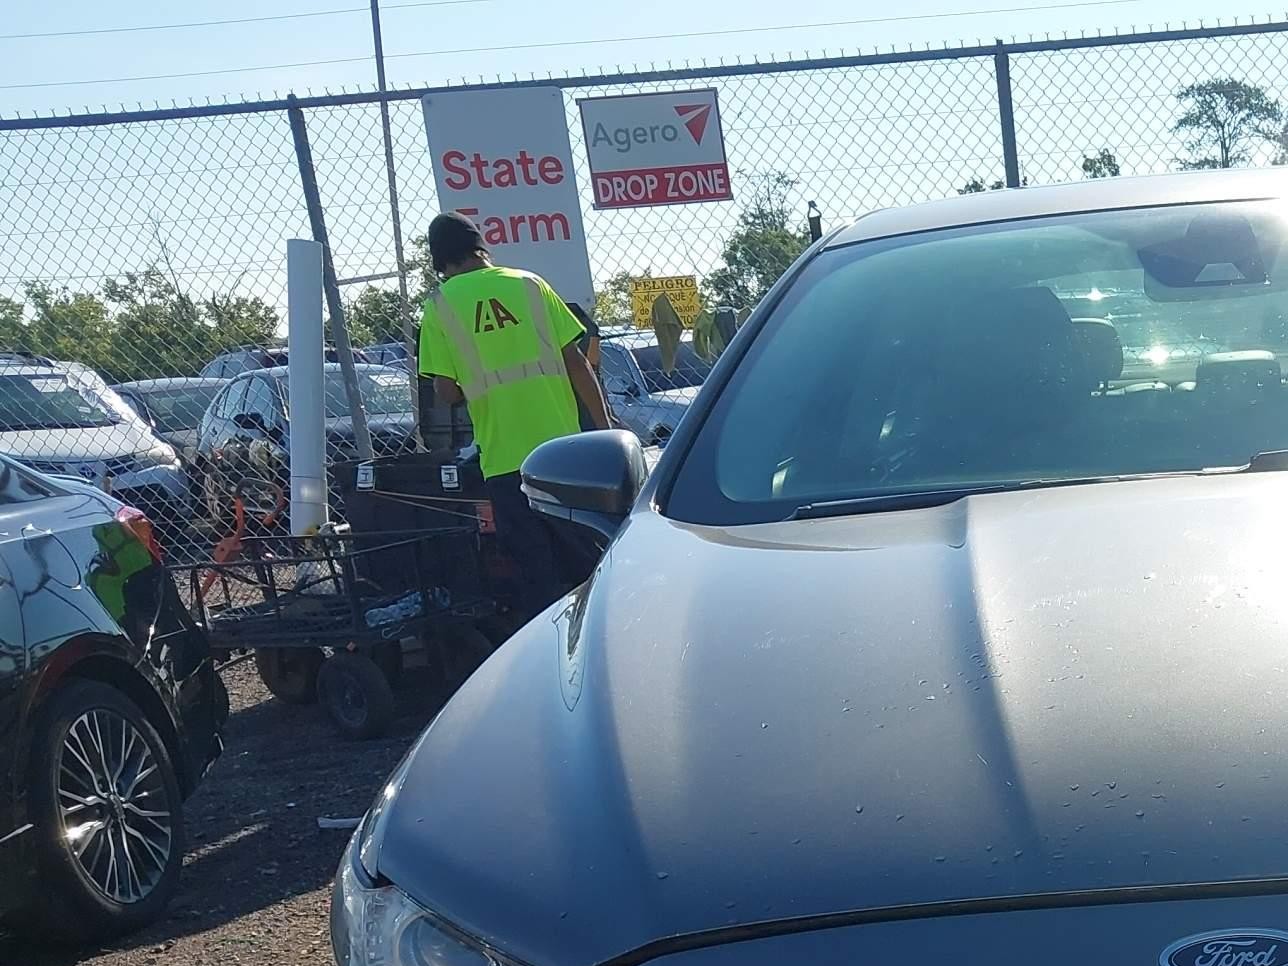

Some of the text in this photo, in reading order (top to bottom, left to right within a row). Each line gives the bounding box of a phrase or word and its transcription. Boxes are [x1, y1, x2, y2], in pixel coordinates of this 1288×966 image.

[591, 122, 678, 153] Agero
[442, 150, 564, 191] State
[596, 169, 726, 203] DROP ZONE
[634, 278, 694, 291] PELIGRO
